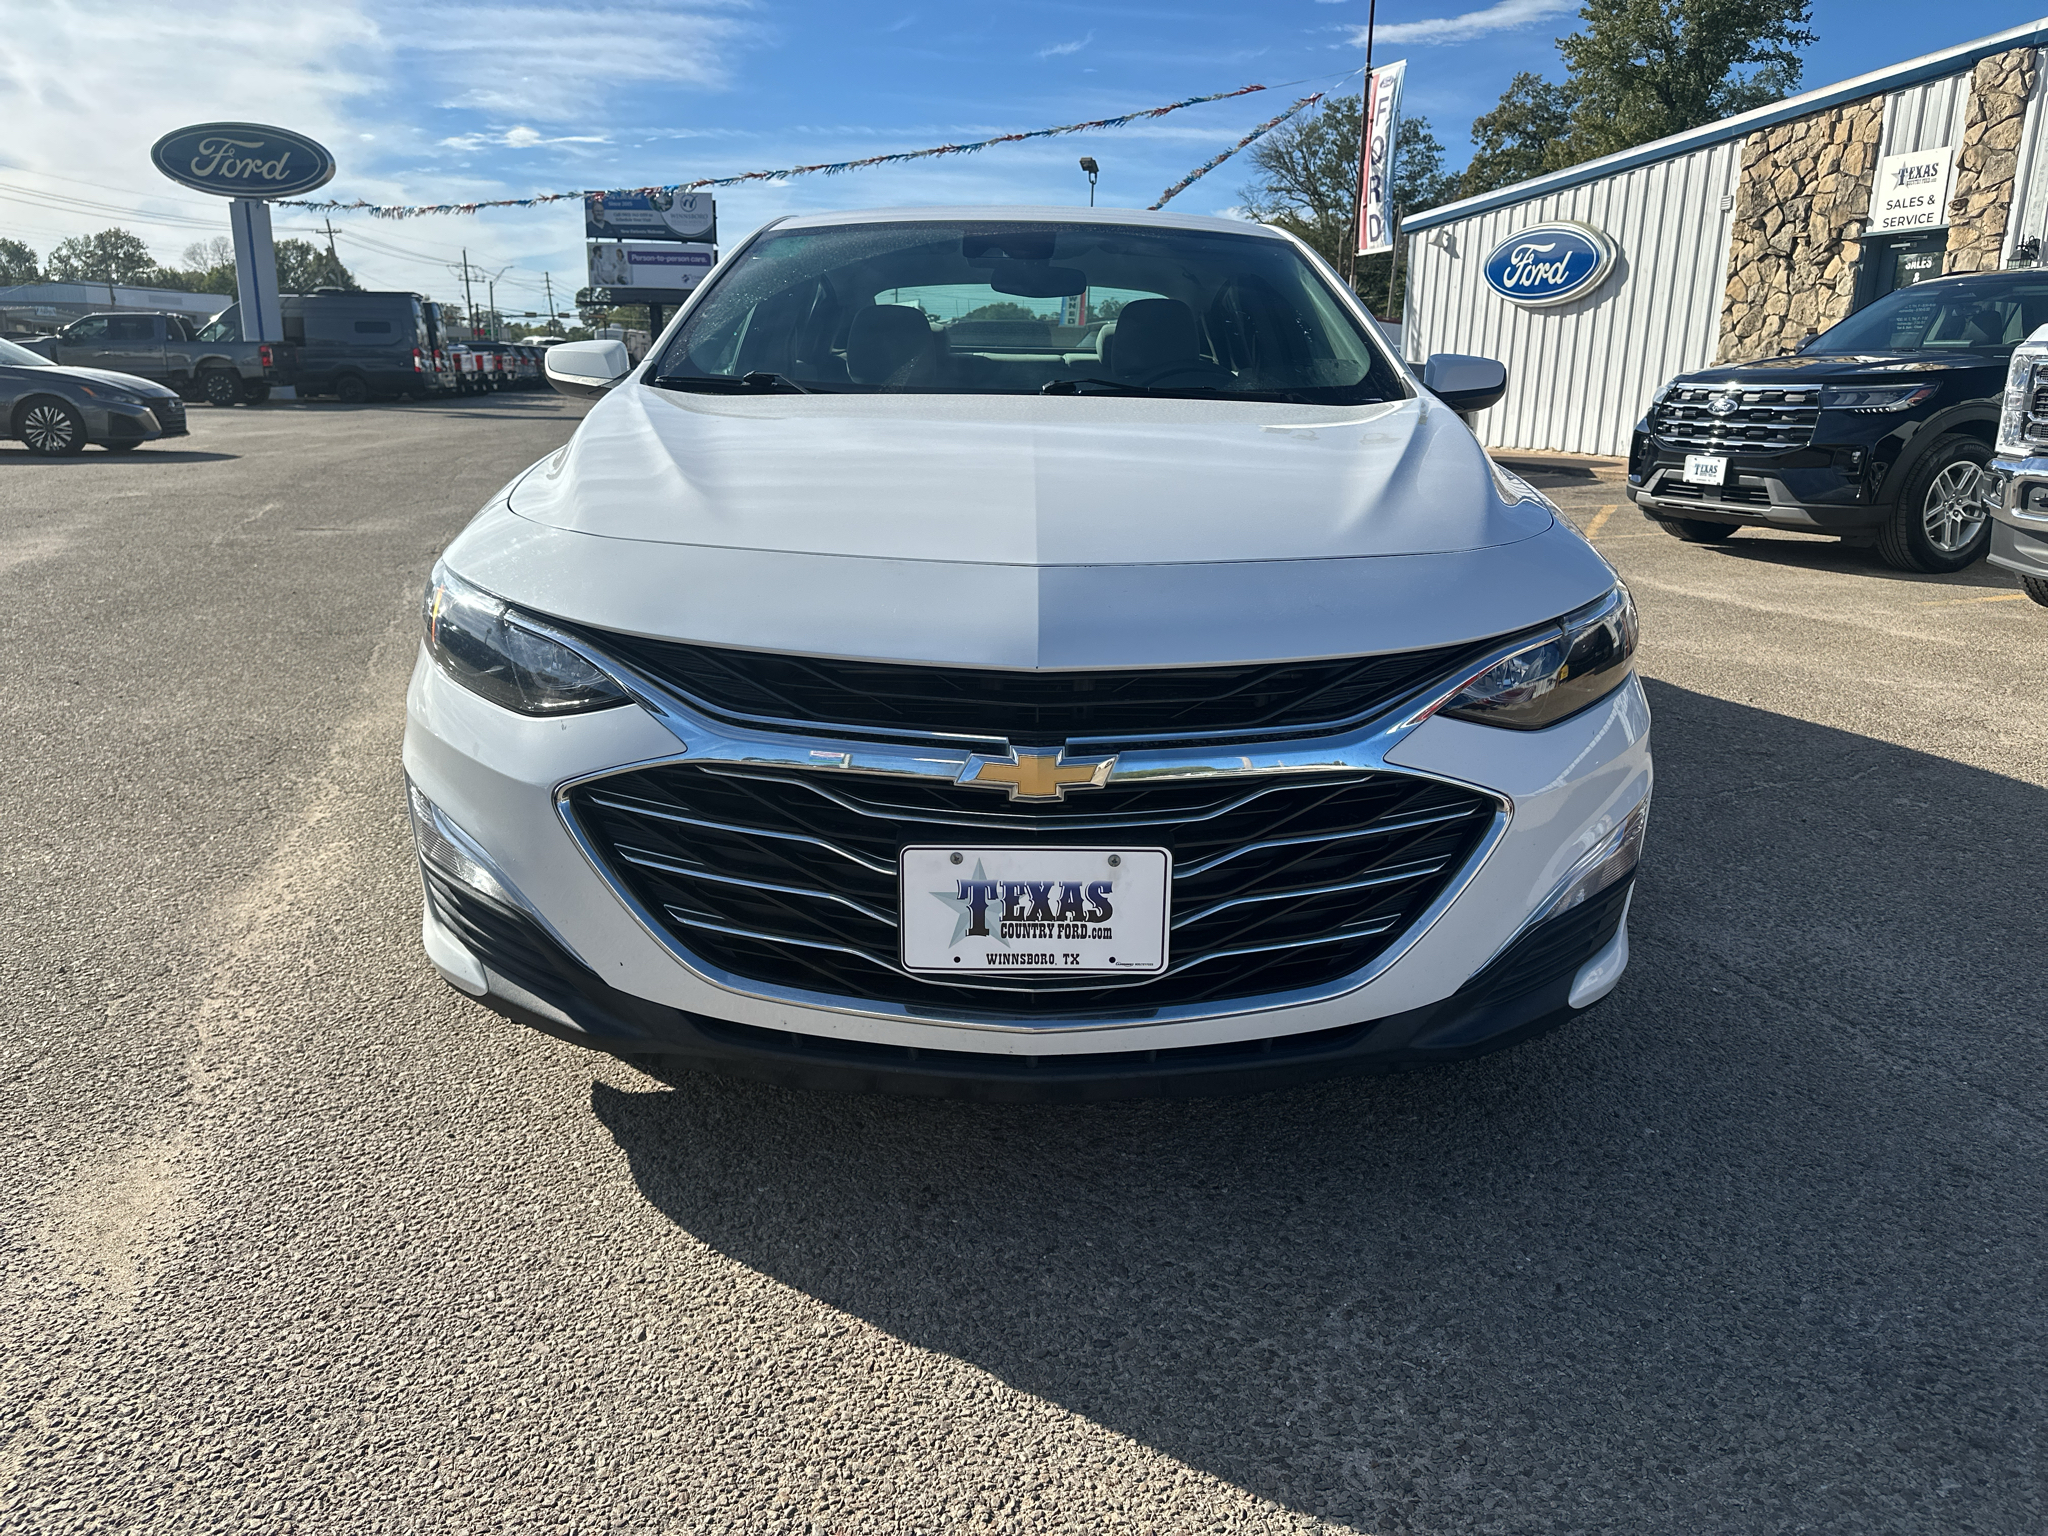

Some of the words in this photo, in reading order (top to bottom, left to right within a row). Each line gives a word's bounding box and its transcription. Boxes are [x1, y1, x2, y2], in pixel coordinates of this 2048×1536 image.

[190, 137, 291, 181] Ford
[1369, 96, 1390, 242] FORD
[1898, 162, 1939, 186] TEXAS
[1886, 196, 1924, 211] SALES
[1927, 194, 1936, 206] &
[1882, 212, 1935, 228] SERVICE
[631, 254, 690, 263] Person-to-person
[1503, 242, 1573, 288] Ford
[1905, 256, 1933, 270] SALES
[1694, 463, 1718, 475] TEXAS
[957, 879, 1114, 937] TEXAS
[1000, 923, 1055, 939] COUNTRY
[1057, 923, 1113, 940] FORD.com
[1062, 953, 1080, 965] TX
